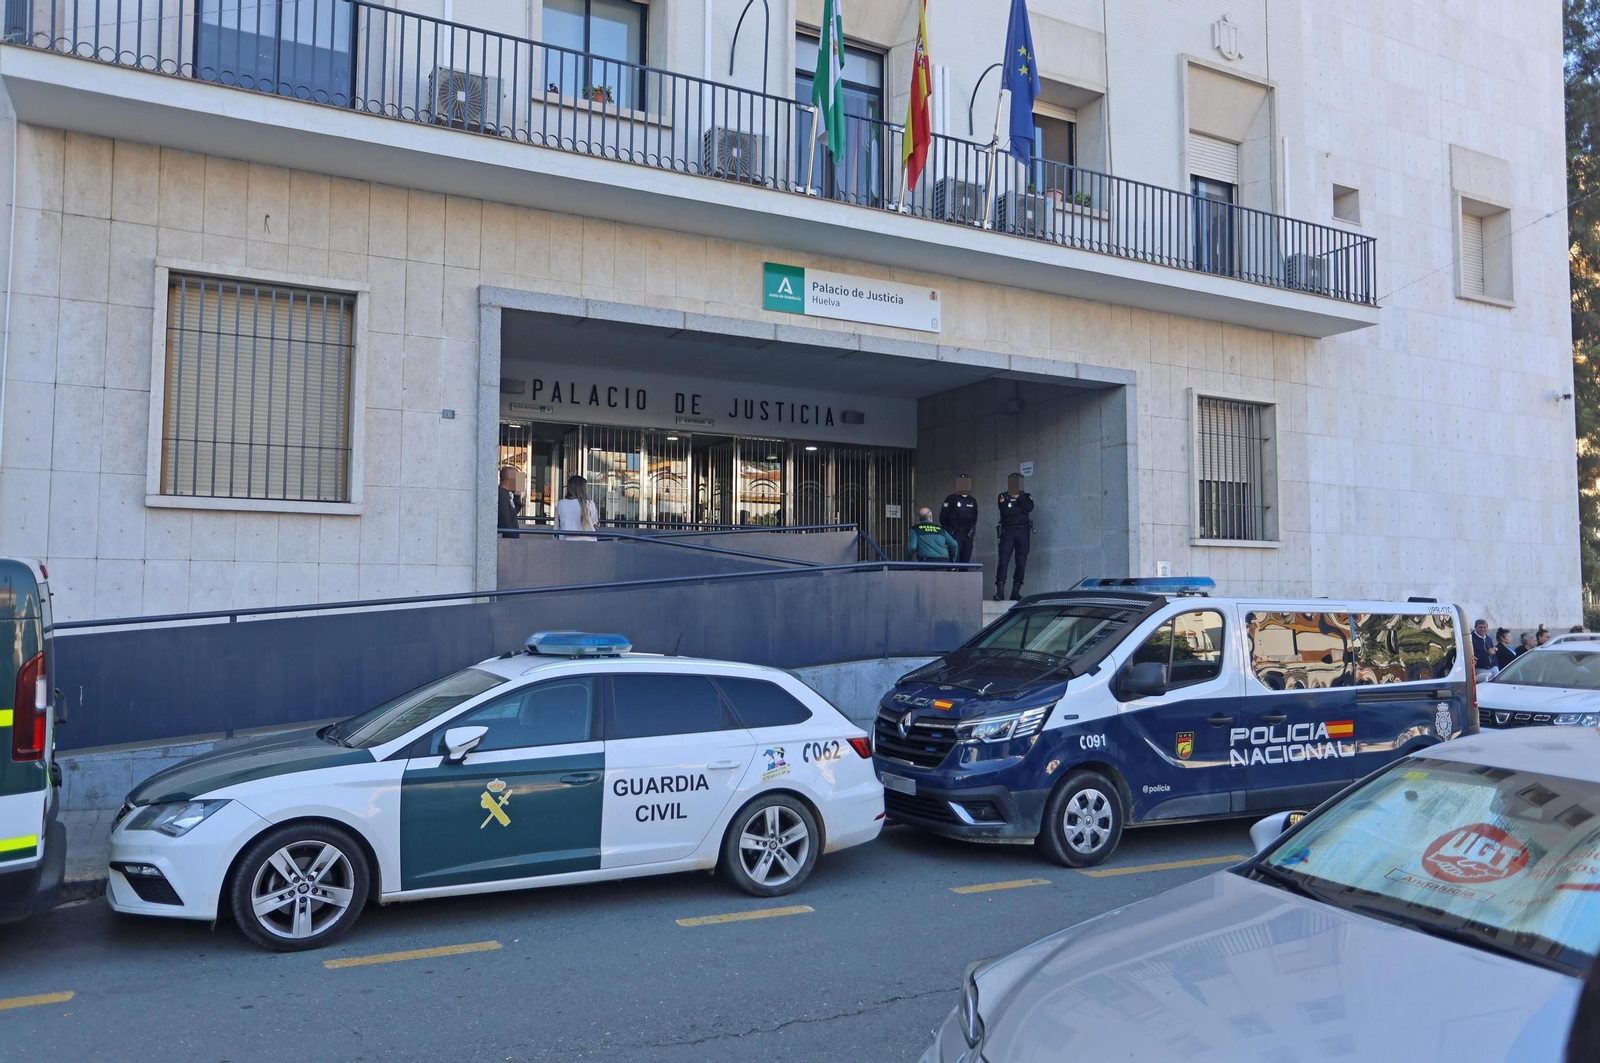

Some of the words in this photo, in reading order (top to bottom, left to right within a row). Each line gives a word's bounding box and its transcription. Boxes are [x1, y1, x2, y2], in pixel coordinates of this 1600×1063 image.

[812, 281, 850, 296] Palacio
[852, 287, 864, 299] de
[866, 290, 904, 305] Justicia
[812, 296, 841, 308] Huelva
[532, 379, 647, 410] PALACIO
[675, 393, 702, 415] DE
[729, 398, 835, 427] JUSTICIA
[812, 740, 841, 762] 062
[1086, 734, 1106, 748] 091
[1229, 741, 1355, 767] NACIONAL
[613, 773, 710, 797] GUARDIA
[1142, 784, 1171, 794] @policia
[635, 802, 688, 823] CIVIL
[1438, 830, 1522, 870] UGT
